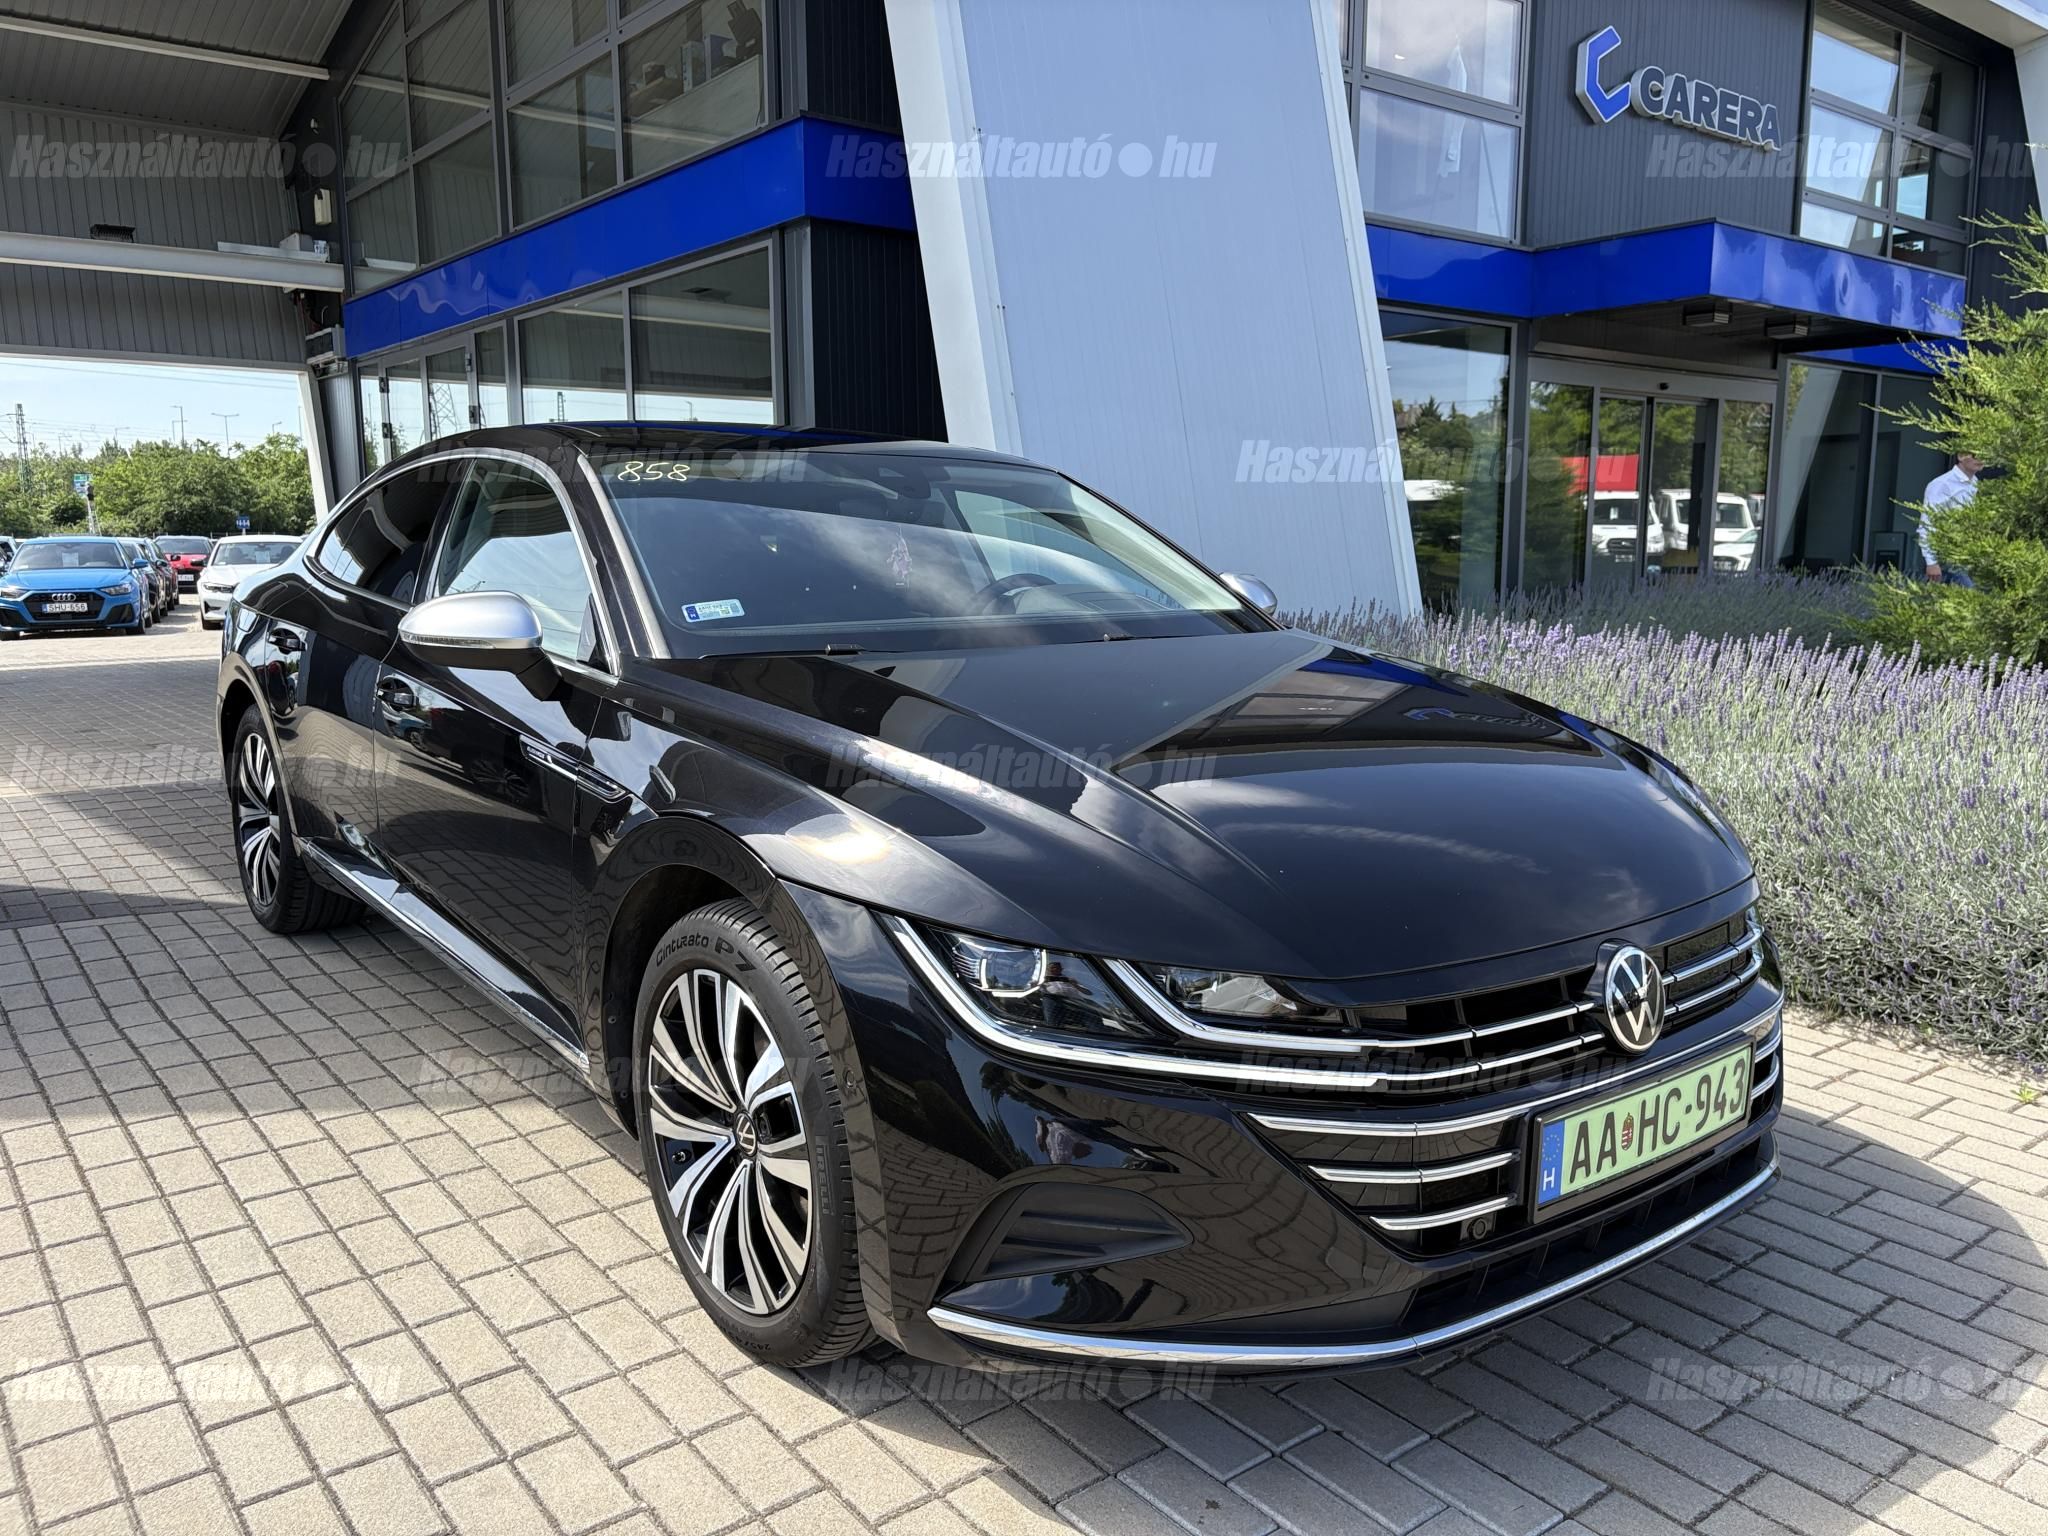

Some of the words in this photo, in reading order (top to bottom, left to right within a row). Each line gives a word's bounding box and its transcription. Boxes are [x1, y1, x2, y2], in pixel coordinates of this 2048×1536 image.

[1634, 65, 1782, 151] CARERA
[617, 460, 691, 482] 858
[714, 936, 757, 972] P7
[1542, 1167, 1555, 1192] H
[1569, 1111, 1617, 1184] AA
